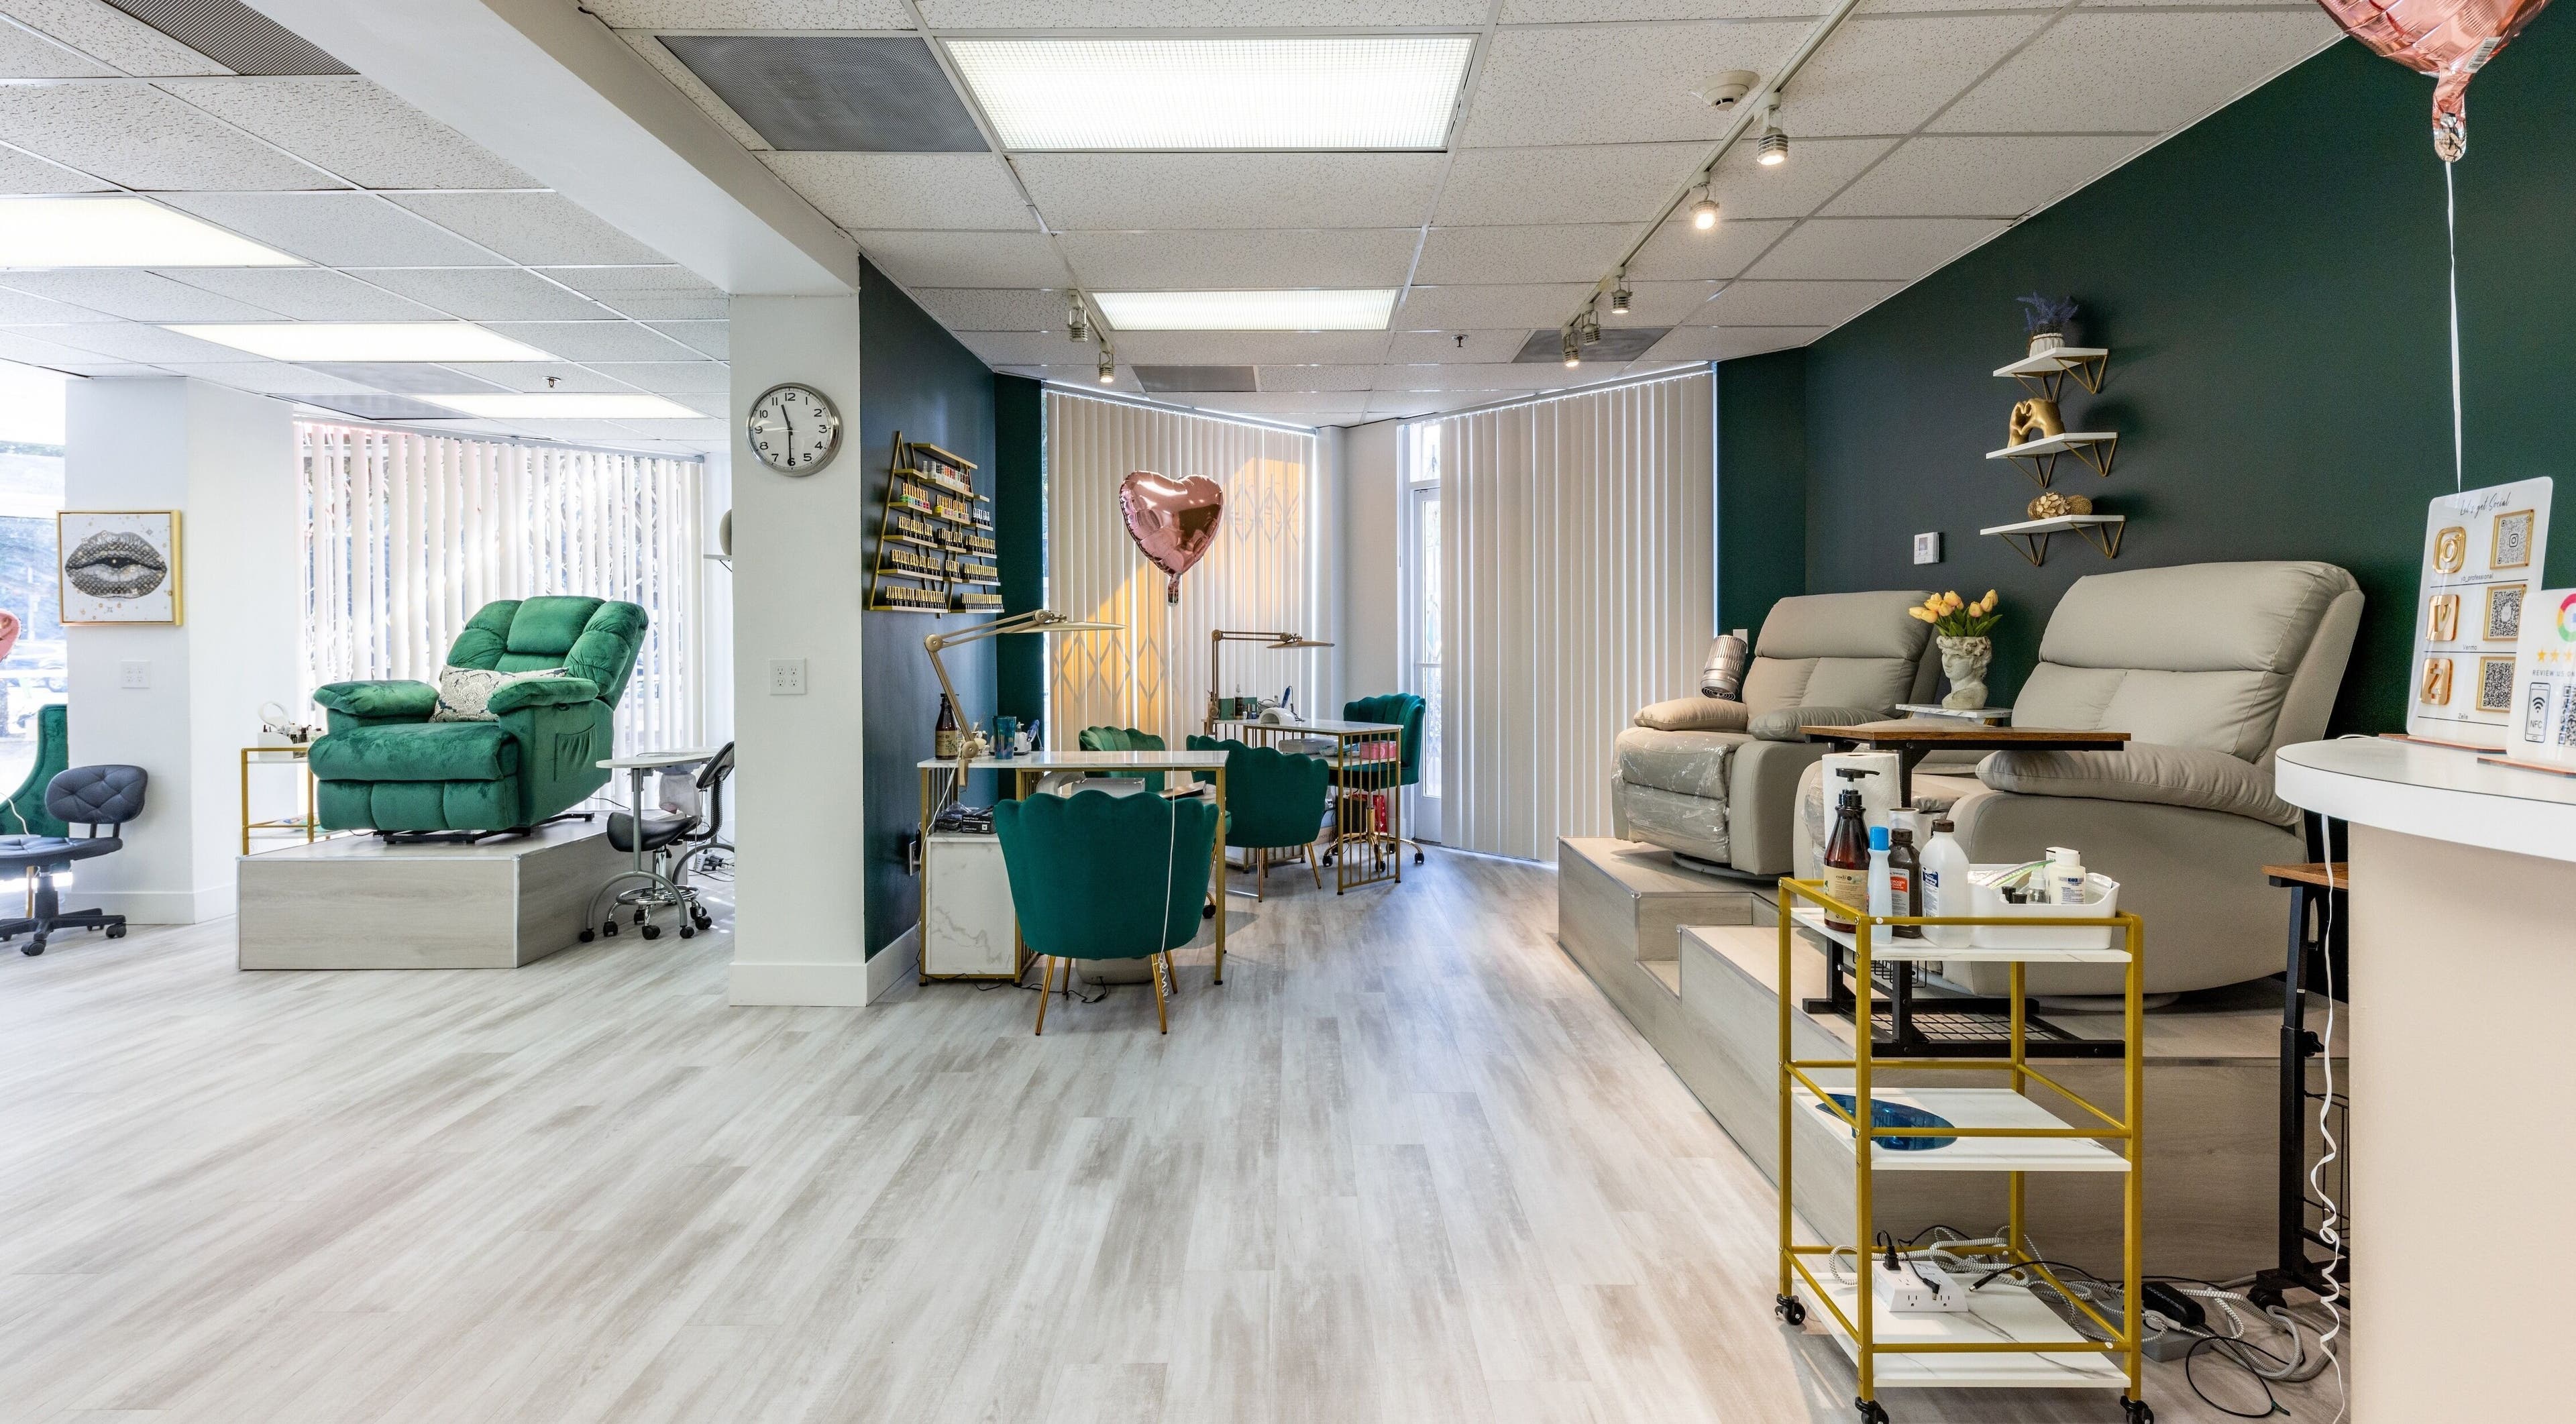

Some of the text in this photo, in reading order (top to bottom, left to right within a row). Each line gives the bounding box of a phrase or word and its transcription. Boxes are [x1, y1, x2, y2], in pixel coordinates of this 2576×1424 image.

[785, 392, 796, 401] 12
[772, 397, 778, 406] 11
[759, 410, 768, 418] 10
[814, 408, 822, 417] 2
[755, 426, 763, 434] 9
[818, 425, 827, 433] 3
[759, 441, 769, 450] 8
[814, 441, 823, 449] 4
[771, 453, 779, 462] 7
[787, 457, 796, 466] 6
[803, 453, 812, 461] 5
[2475, 496, 2489, 518] get
[2489, 492, 2511, 511] Social
[2530, 720, 2542, 728] NFC
